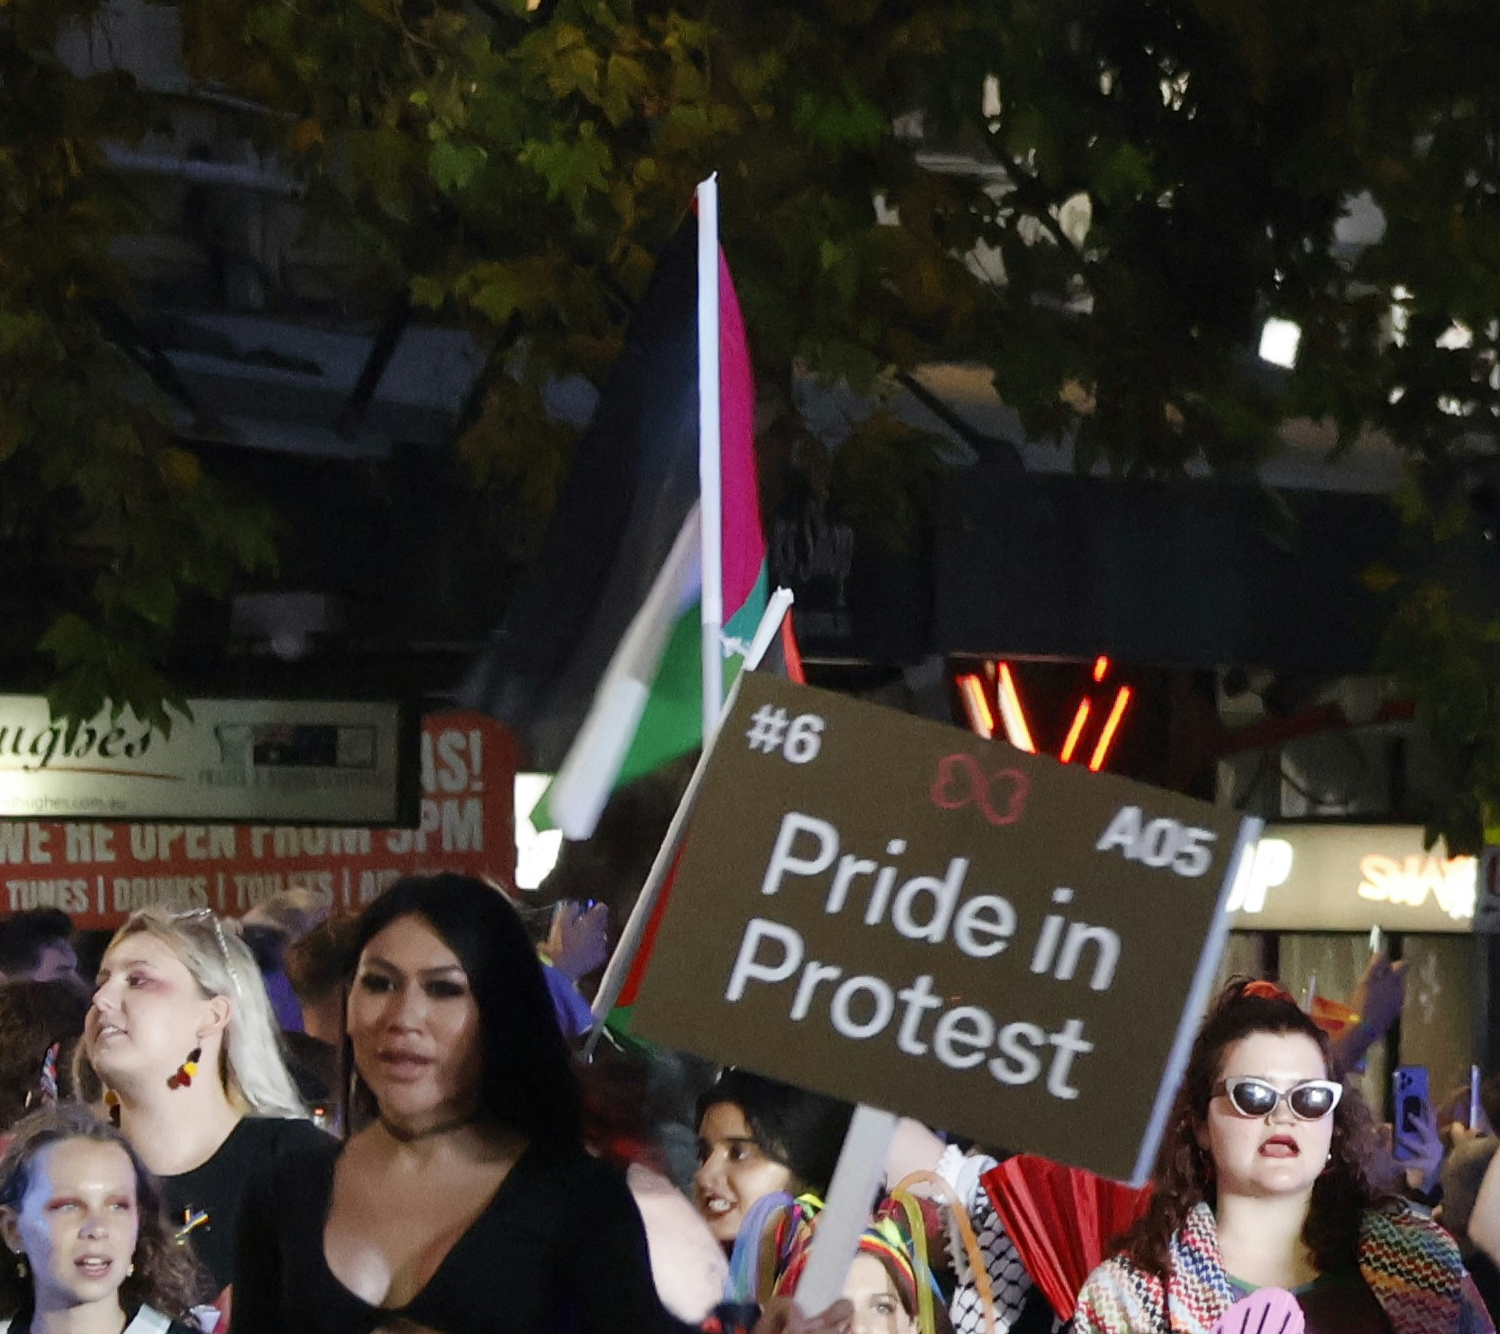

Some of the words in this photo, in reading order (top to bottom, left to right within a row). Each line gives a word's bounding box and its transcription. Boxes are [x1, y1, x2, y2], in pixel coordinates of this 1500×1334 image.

[746, 703, 825, 764] #6
[1096, 805, 1219, 878] A05
[760, 810, 1018, 959] Pride
[1029, 887, 1122, 991] in
[725, 917, 1095, 1100] Protest
